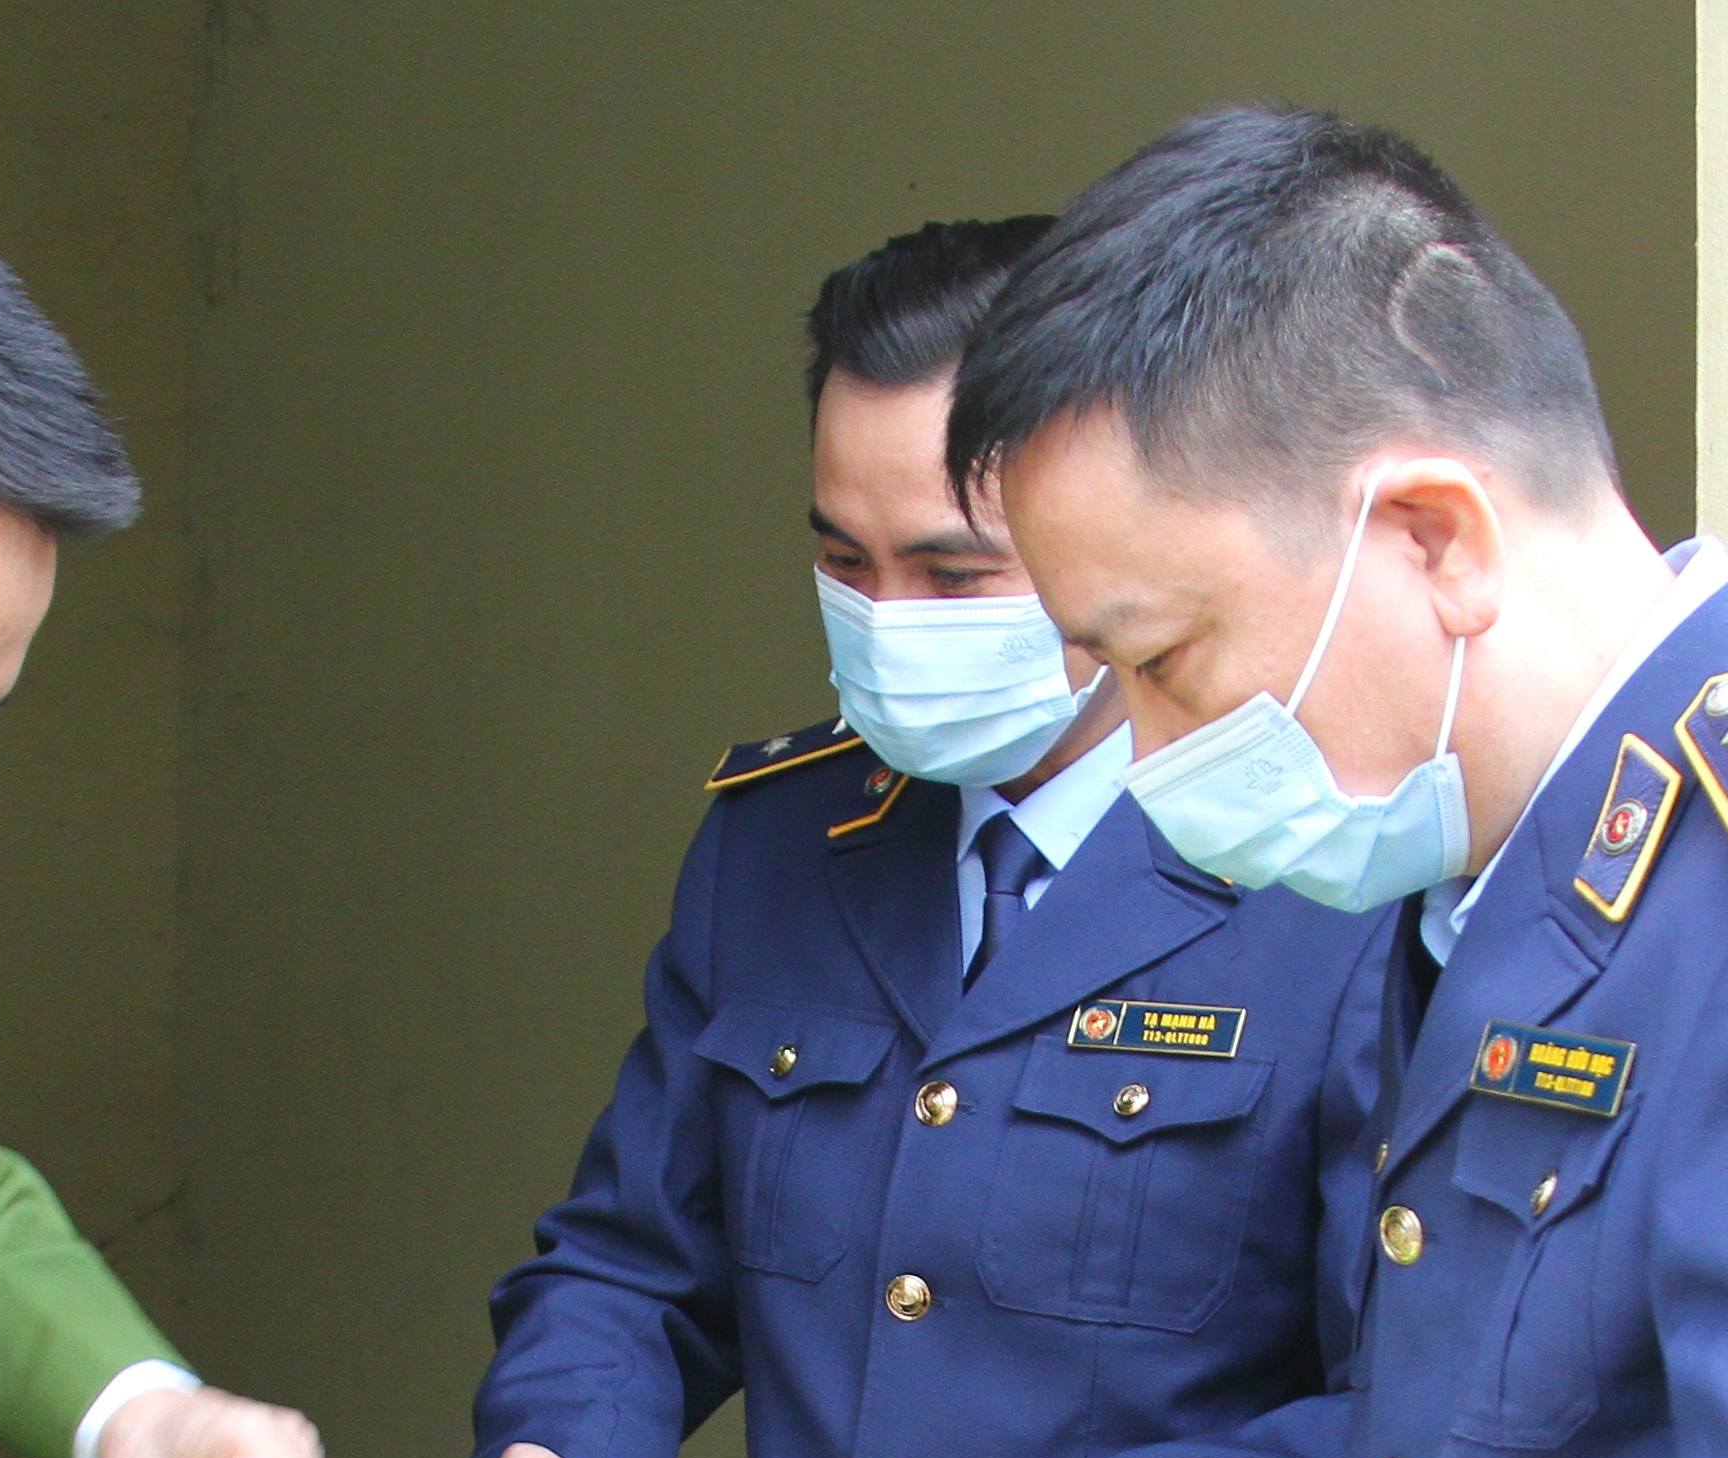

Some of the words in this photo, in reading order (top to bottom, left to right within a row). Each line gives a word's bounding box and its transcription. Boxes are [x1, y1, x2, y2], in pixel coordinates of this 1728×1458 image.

[1143, 1011, 1159, 1029] TẠ
[1160, 1013, 1197, 1030] MẠNH
[1198, 1014, 1216, 1030] HÀ
